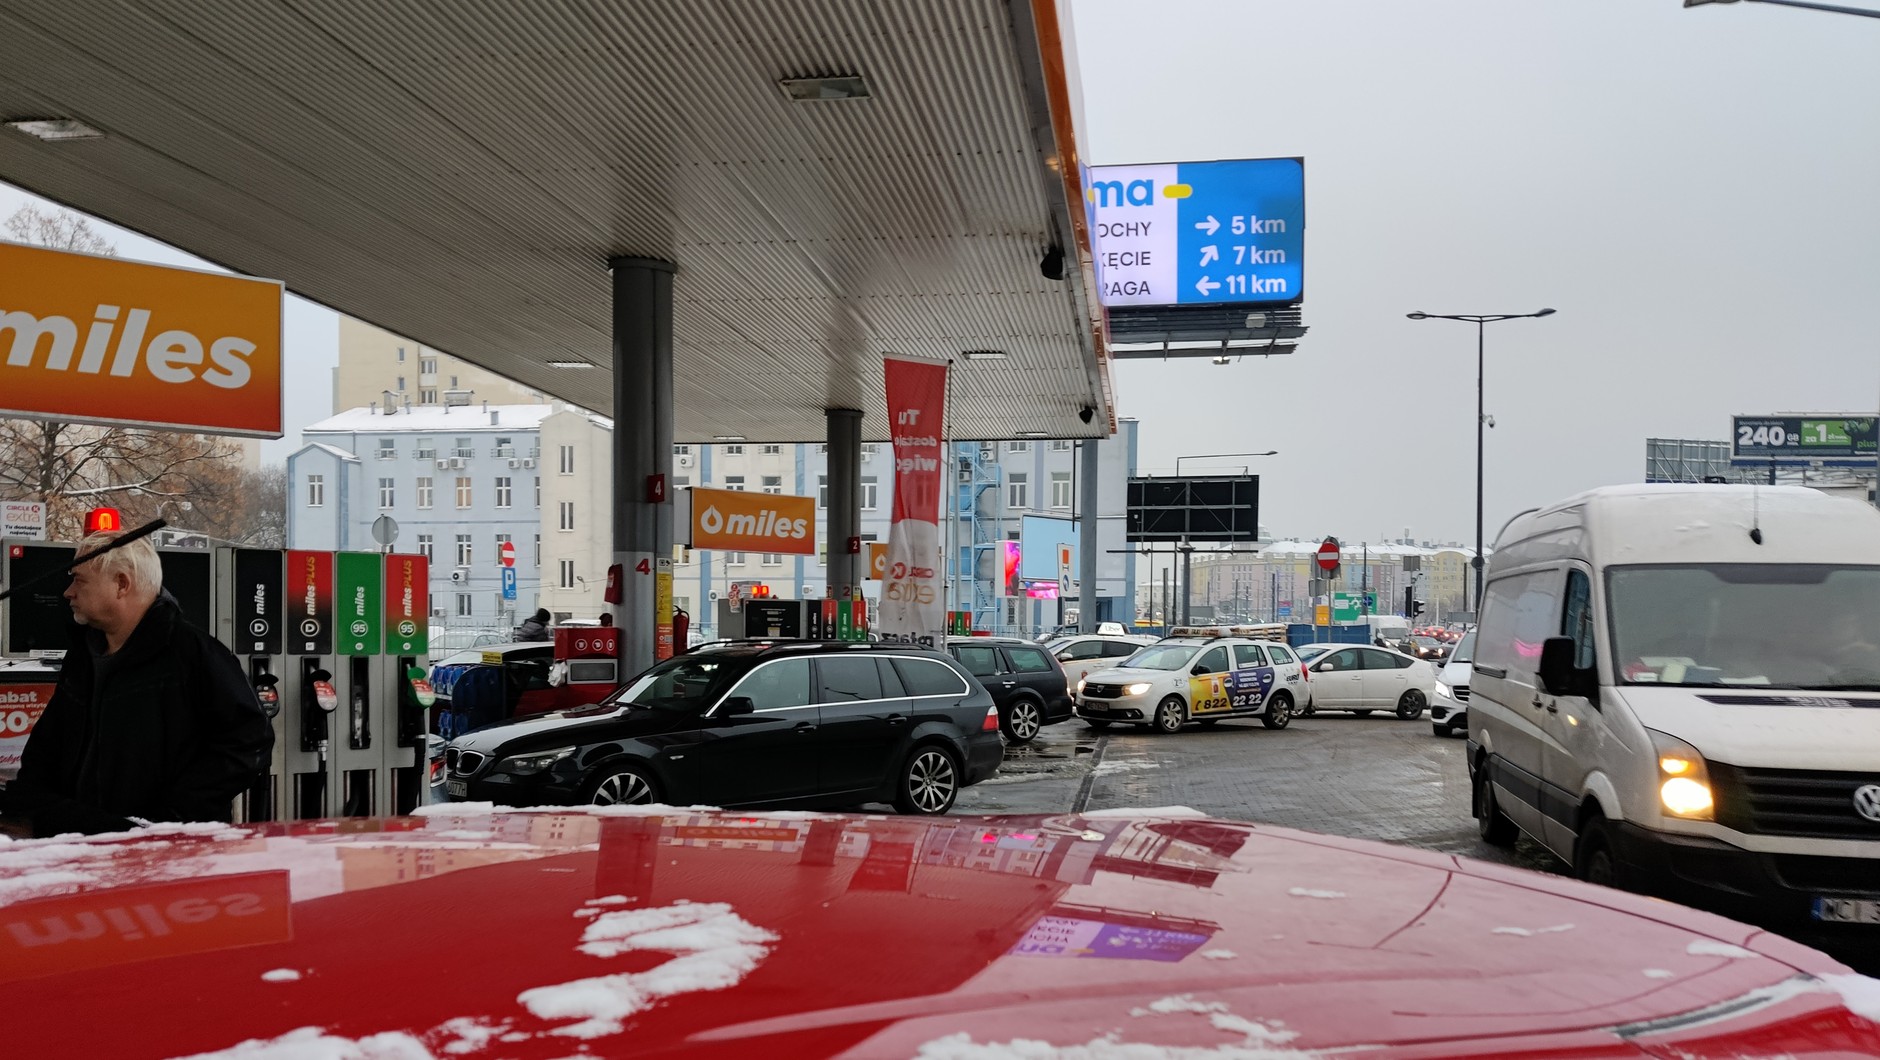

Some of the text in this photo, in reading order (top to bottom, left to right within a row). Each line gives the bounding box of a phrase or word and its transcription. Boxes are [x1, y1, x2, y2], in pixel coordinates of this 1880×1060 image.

[1093, 179, 1154, 208] ma
[1231, 215, 1246, 235] 5
[1251, 215, 1286, 234] km
[1232, 246, 1246, 265] 7
[1251, 246, 1286, 265] km
[1225, 275, 1246, 295] 11
[1251, 274, 1287, 294] km
[0, 304, 257, 389] miles
[1738, 426, 1786, 447] 240
[1815, 423, 1827, 443] 1
[1857, 440, 1877, 449] plus
[655, 481, 662, 495] 4
[6, 510, 41, 523] extra
[725, 510, 808, 539] miles
[853, 541, 858, 550] 2
[635, 558, 651, 576] 4
[505, 569, 514, 590] P
[254, 583, 265, 615] miles
[843, 586, 851, 597] 2
[354, 586, 365, 616] miles
[254, 623, 265, 633] D
[305, 623, 315, 633] D
[352, 624, 366, 633] 95
[400, 624, 414, 633] 95
[1203, 693, 1262, 710] 822 22 22
